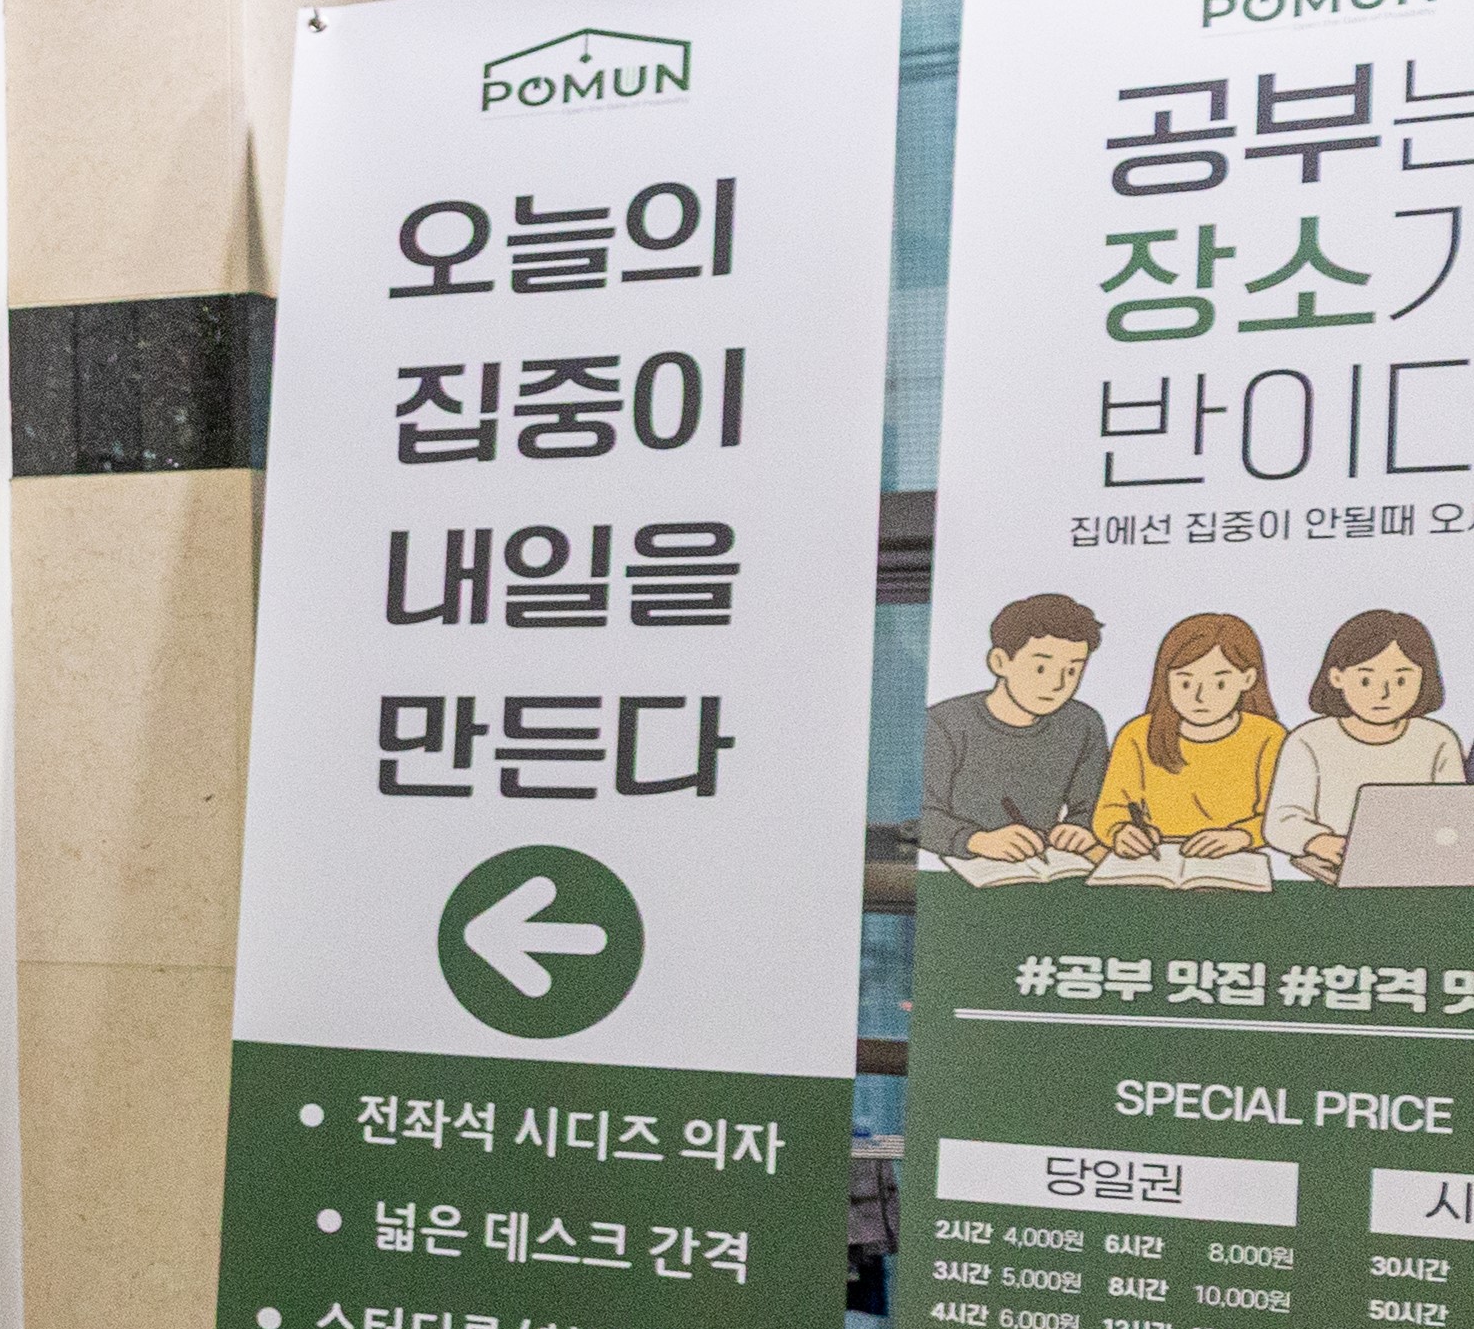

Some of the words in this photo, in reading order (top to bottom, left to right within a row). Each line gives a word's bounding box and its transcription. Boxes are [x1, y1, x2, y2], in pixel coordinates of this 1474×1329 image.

[481, 63, 691, 112] POMUN
[388, 177, 738, 301] 오늘의
[394, 346, 747, 467] 집중이
[1070, 512, 1172, 548] 집에선
[1186, 509, 1290, 544] 집중이
[1305, 504, 1416, 540] 안될때
[1429, 501, 1474, 537] 오
[384, 519, 742, 630] 내일을
[377, 693, 737, 802] 만든다
[1016, 955, 1152, 1001] #공부
[1167, 961, 1265, 1007] 맛집
[1279, 964, 1427, 1014] #합격
[1114, 1079, 1302, 1126] SPECIAL
[1315, 1091, 1455, 1134] PRICE
[356, 1094, 497, 1150] 전좌석
[513, 1104, 663, 1165] 시디즈
[680, 1119, 786, 1177] 의자
[1045, 1156, 1183, 1204] 당일권
[373, 1201, 468, 1259] 넓은
[483, 1210, 632, 1273] 데스크
[649, 1226, 749, 1284] 간격
[936, 1220, 993, 1245] 2시간
[1003, 1226, 1084, 1253] 4,000원
[1105, 1234, 1164, 1259] 6시간
[1208, 1243, 1294, 1271] 8,000원
[1371, 1256, 1450, 1282] 30시간
[933, 1261, 990, 1287] 3시간
[1001, 1267, 1082, 1294] 5,000원
[1108, 1277, 1168, 1302] 8시간
[1194, 1285, 1291, 1314] 10,000원
[1369, 1300, 1449, 1327] 50시간
[930, 1302, 989, 1328] 4시간
